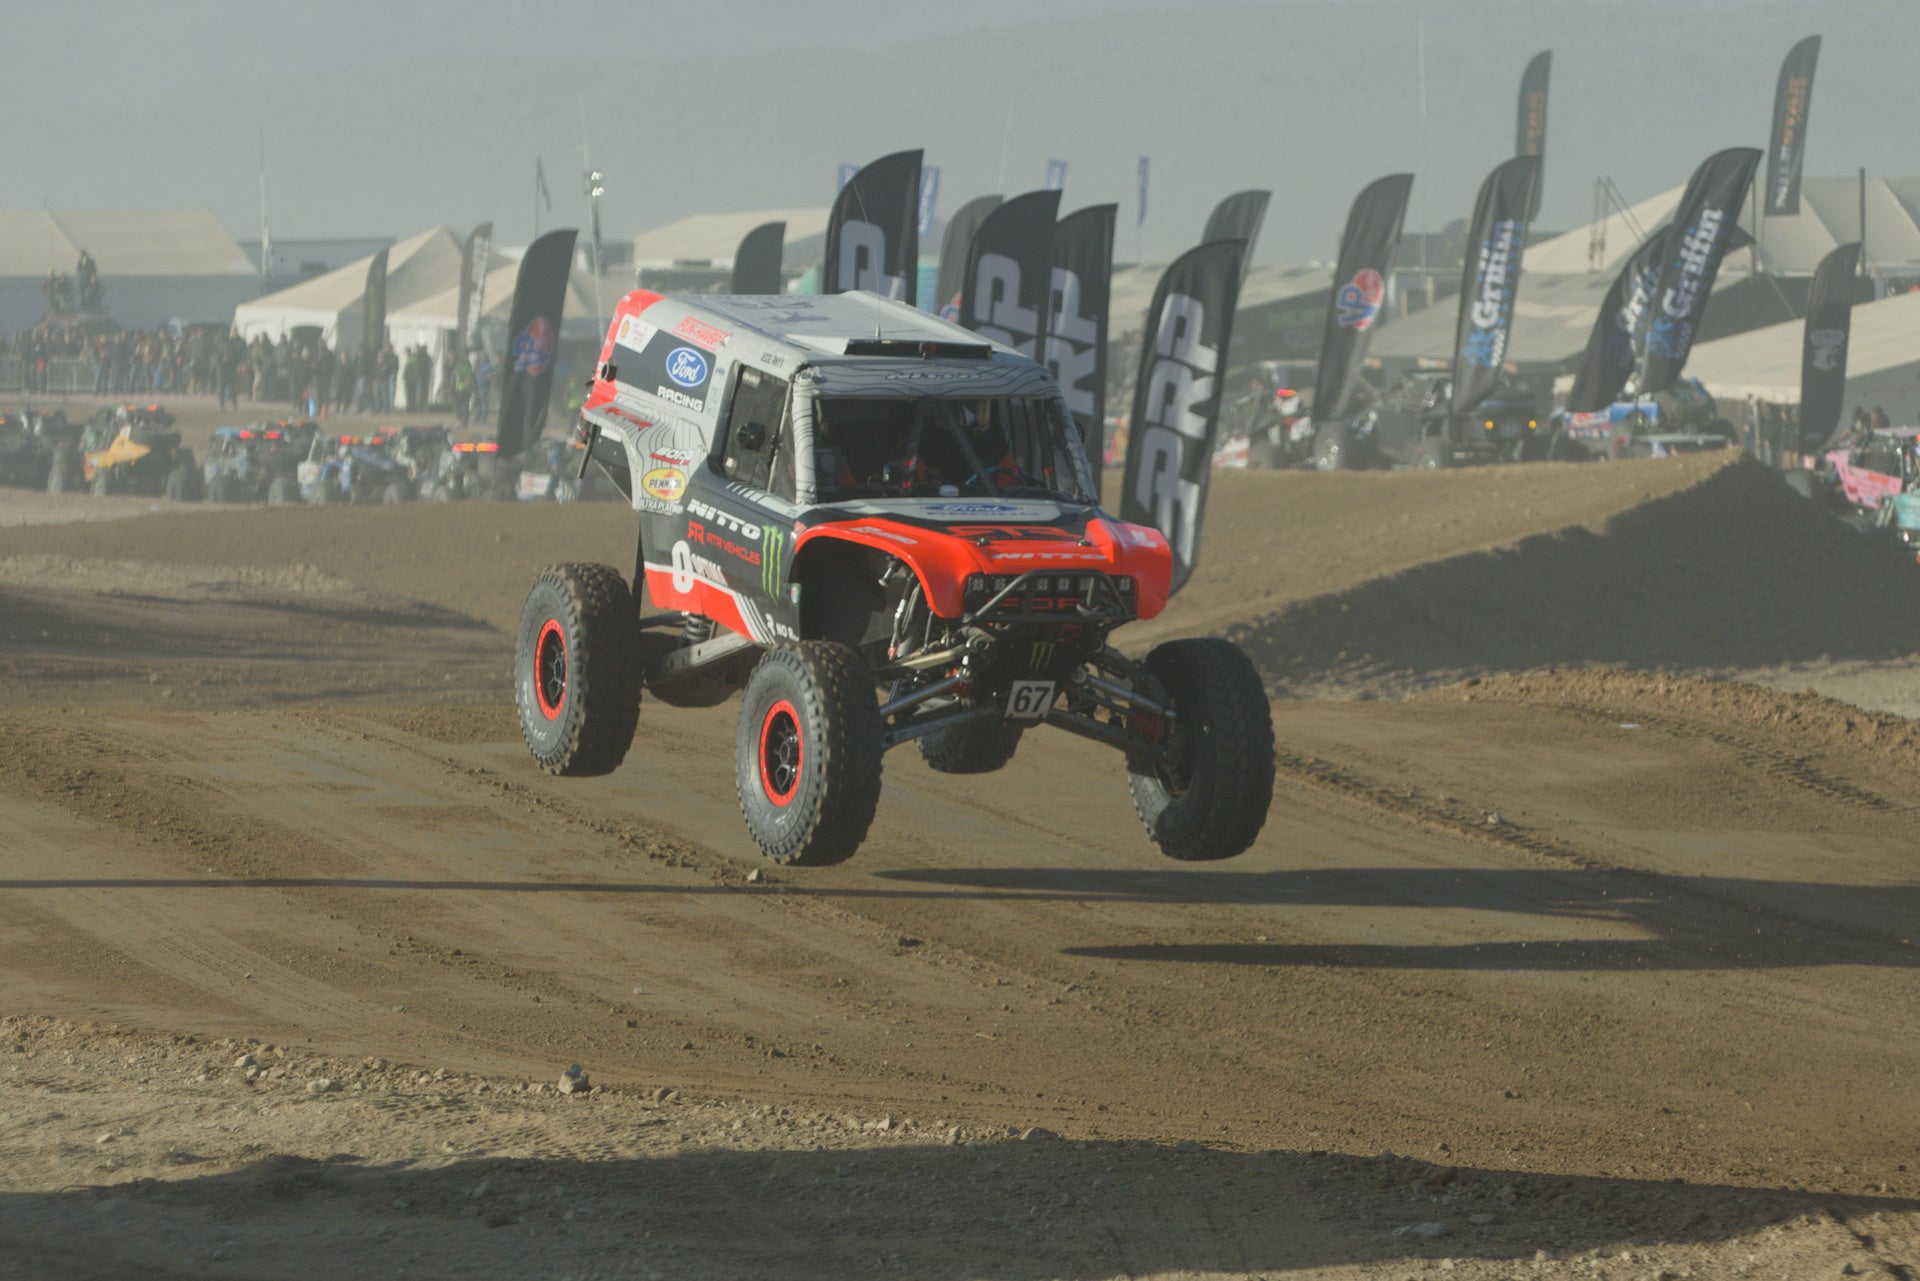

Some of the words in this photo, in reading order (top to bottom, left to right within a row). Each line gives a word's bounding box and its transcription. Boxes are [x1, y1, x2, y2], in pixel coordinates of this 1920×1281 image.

[1662, 209, 1724, 318] Griffin
[657, 385, 704, 413] RACING
[1136, 292, 1219, 568] PRP
[687, 498, 761, 540] NITTO
[1015, 685, 1050, 714] 67
